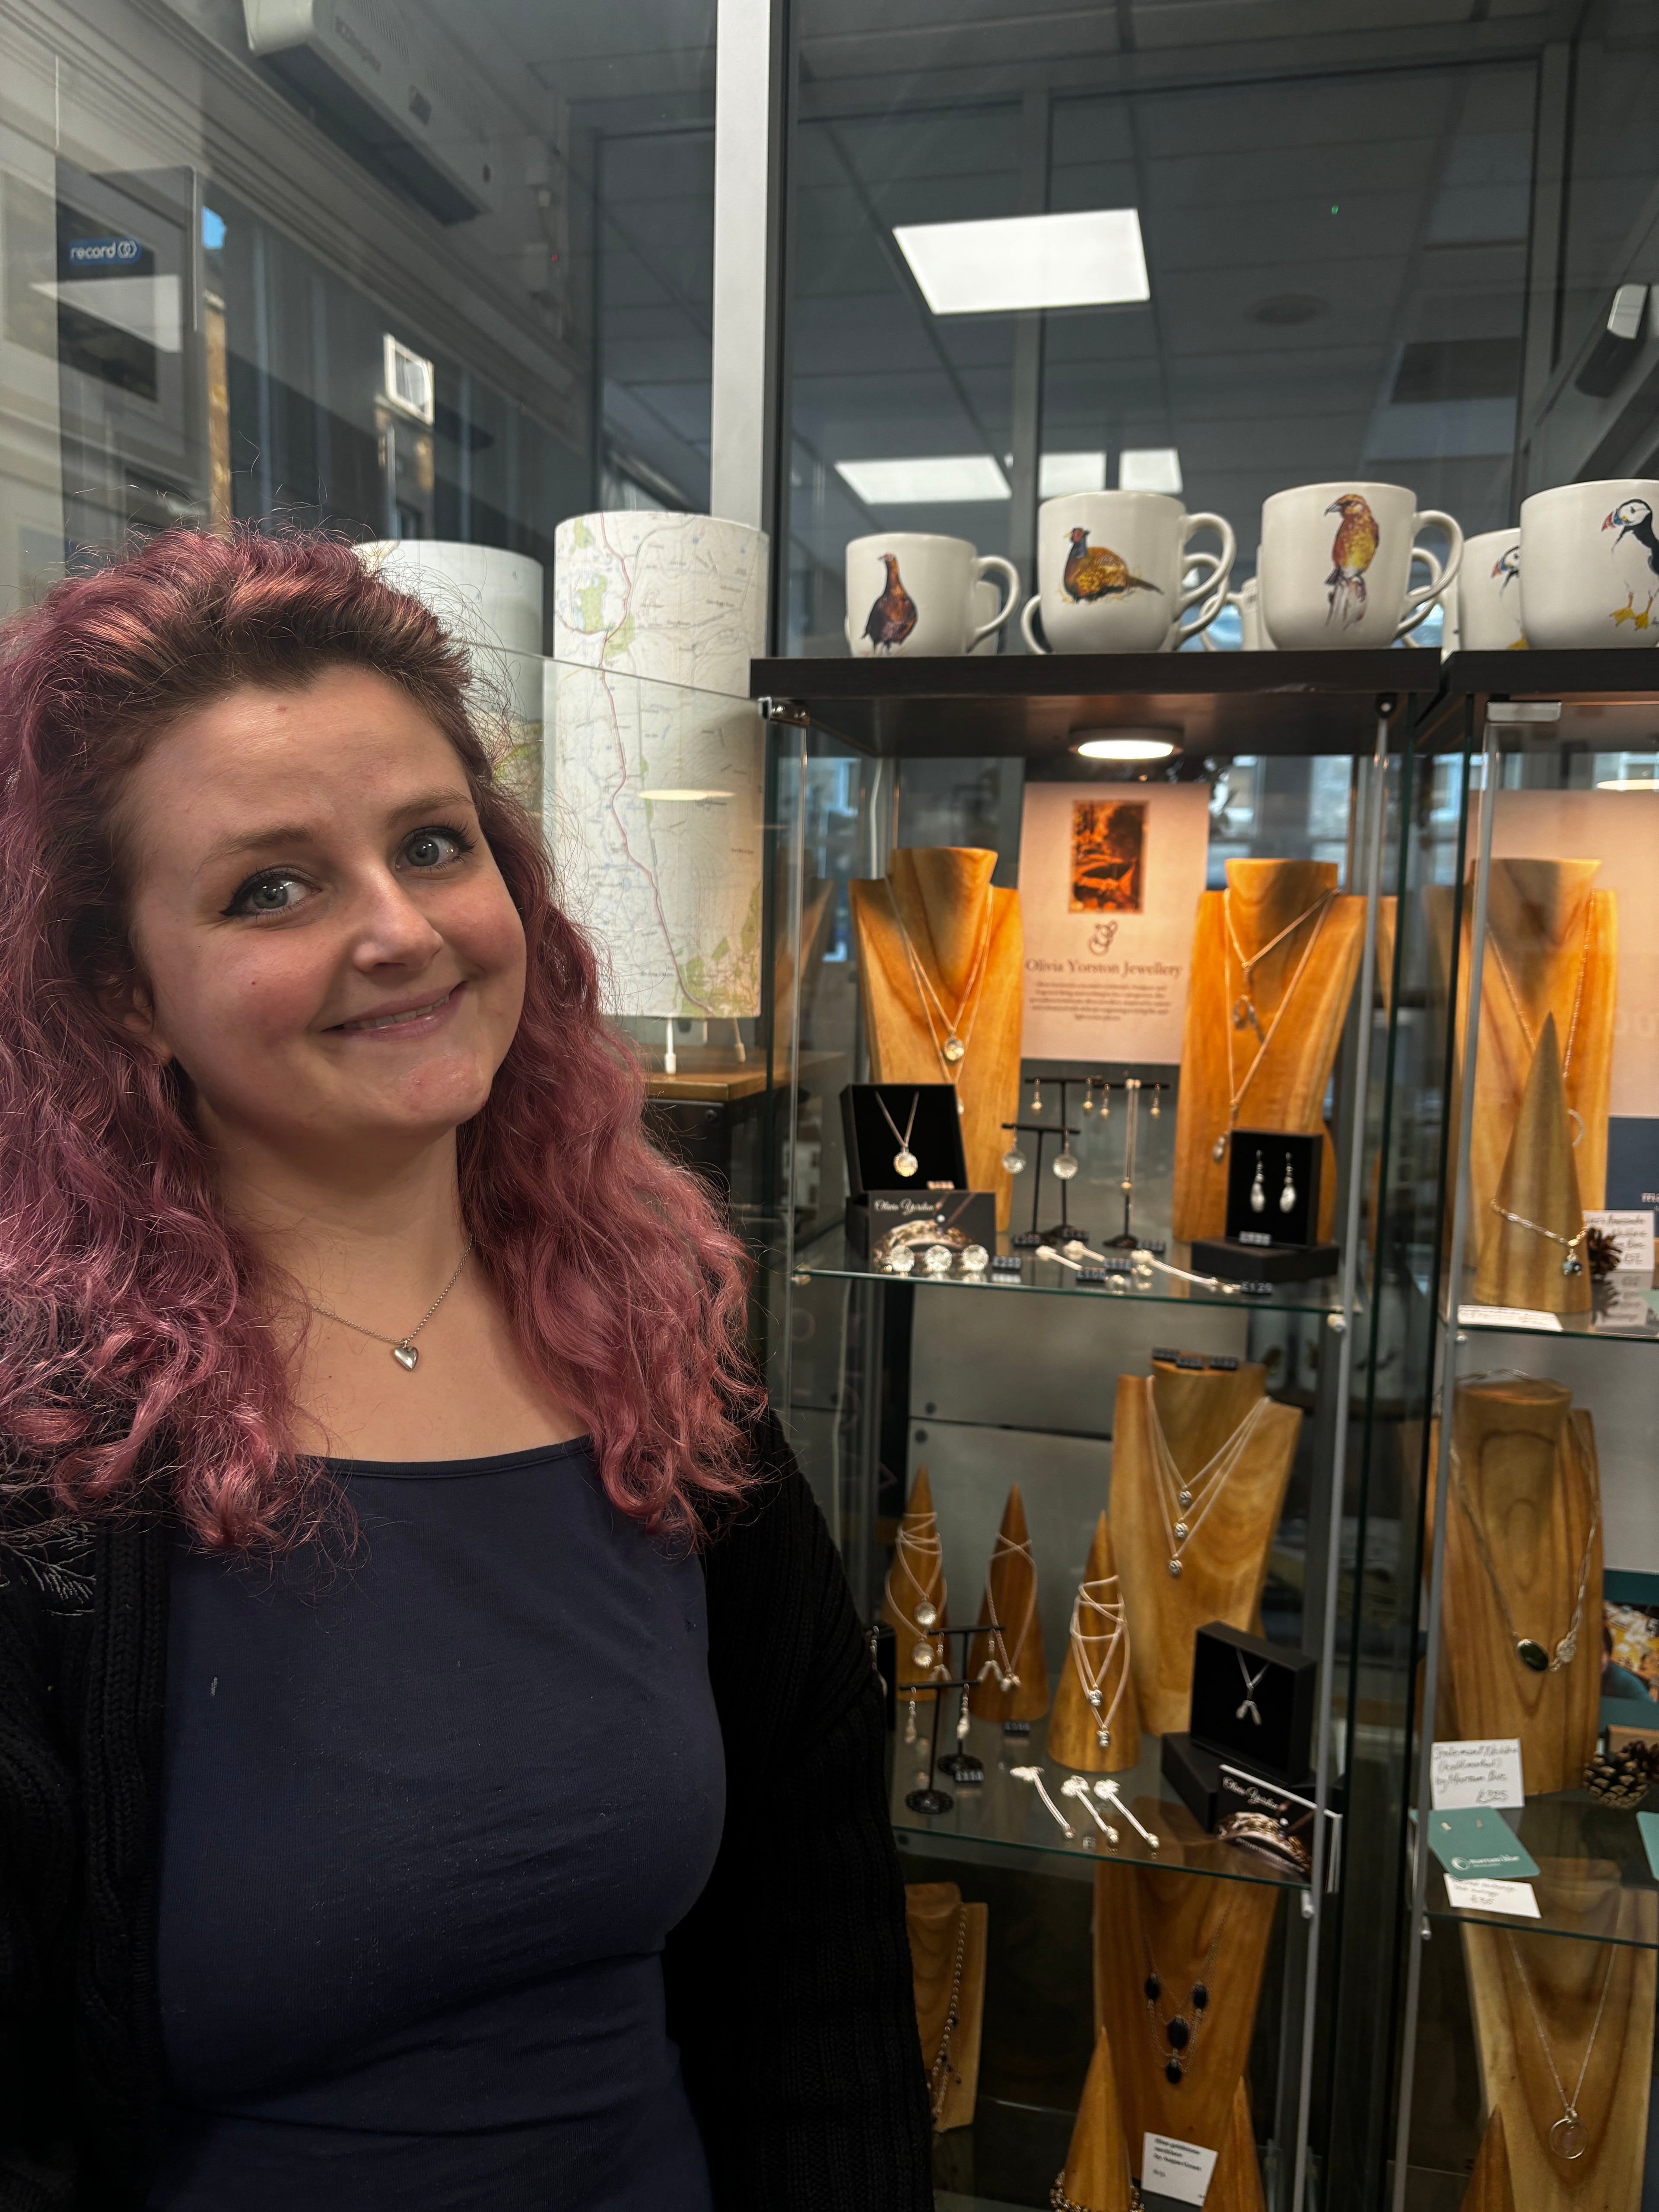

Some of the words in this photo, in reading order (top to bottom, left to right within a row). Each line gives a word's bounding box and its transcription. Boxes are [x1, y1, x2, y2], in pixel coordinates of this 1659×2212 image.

[70, 242, 116, 259] record
[1025, 958, 1063, 972] Olivia
[1121, 960, 1183, 980] Jewellery
